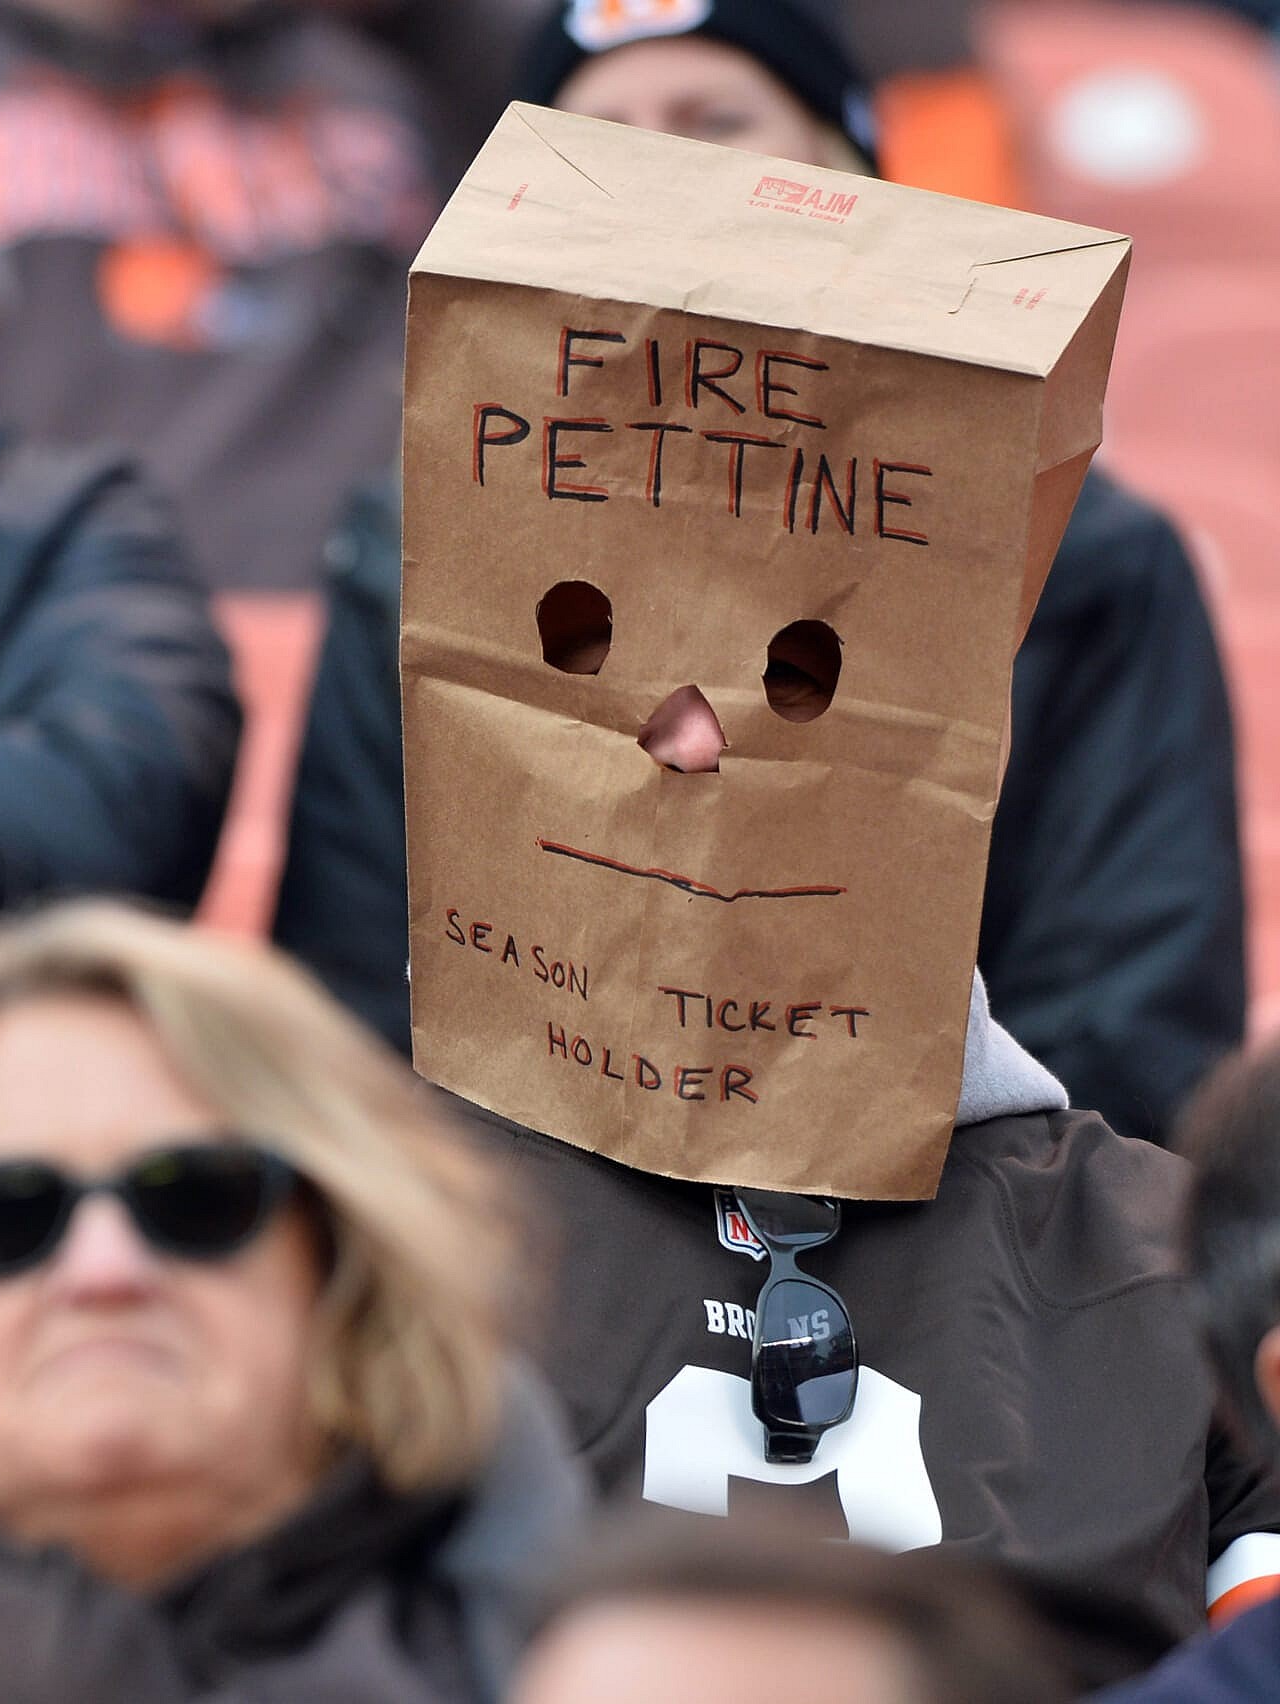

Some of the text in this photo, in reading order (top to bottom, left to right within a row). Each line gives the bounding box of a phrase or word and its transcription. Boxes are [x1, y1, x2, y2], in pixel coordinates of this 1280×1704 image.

[803, 188, 859, 217] AJM
[557, 327, 829, 429] FIRE
[472, 403, 933, 546] PETTINE
[445, 908, 870, 1039] SEASON TICKET
[548, 1021, 758, 1104] HOLDER
[703, 1299, 831, 1348] BRONS
